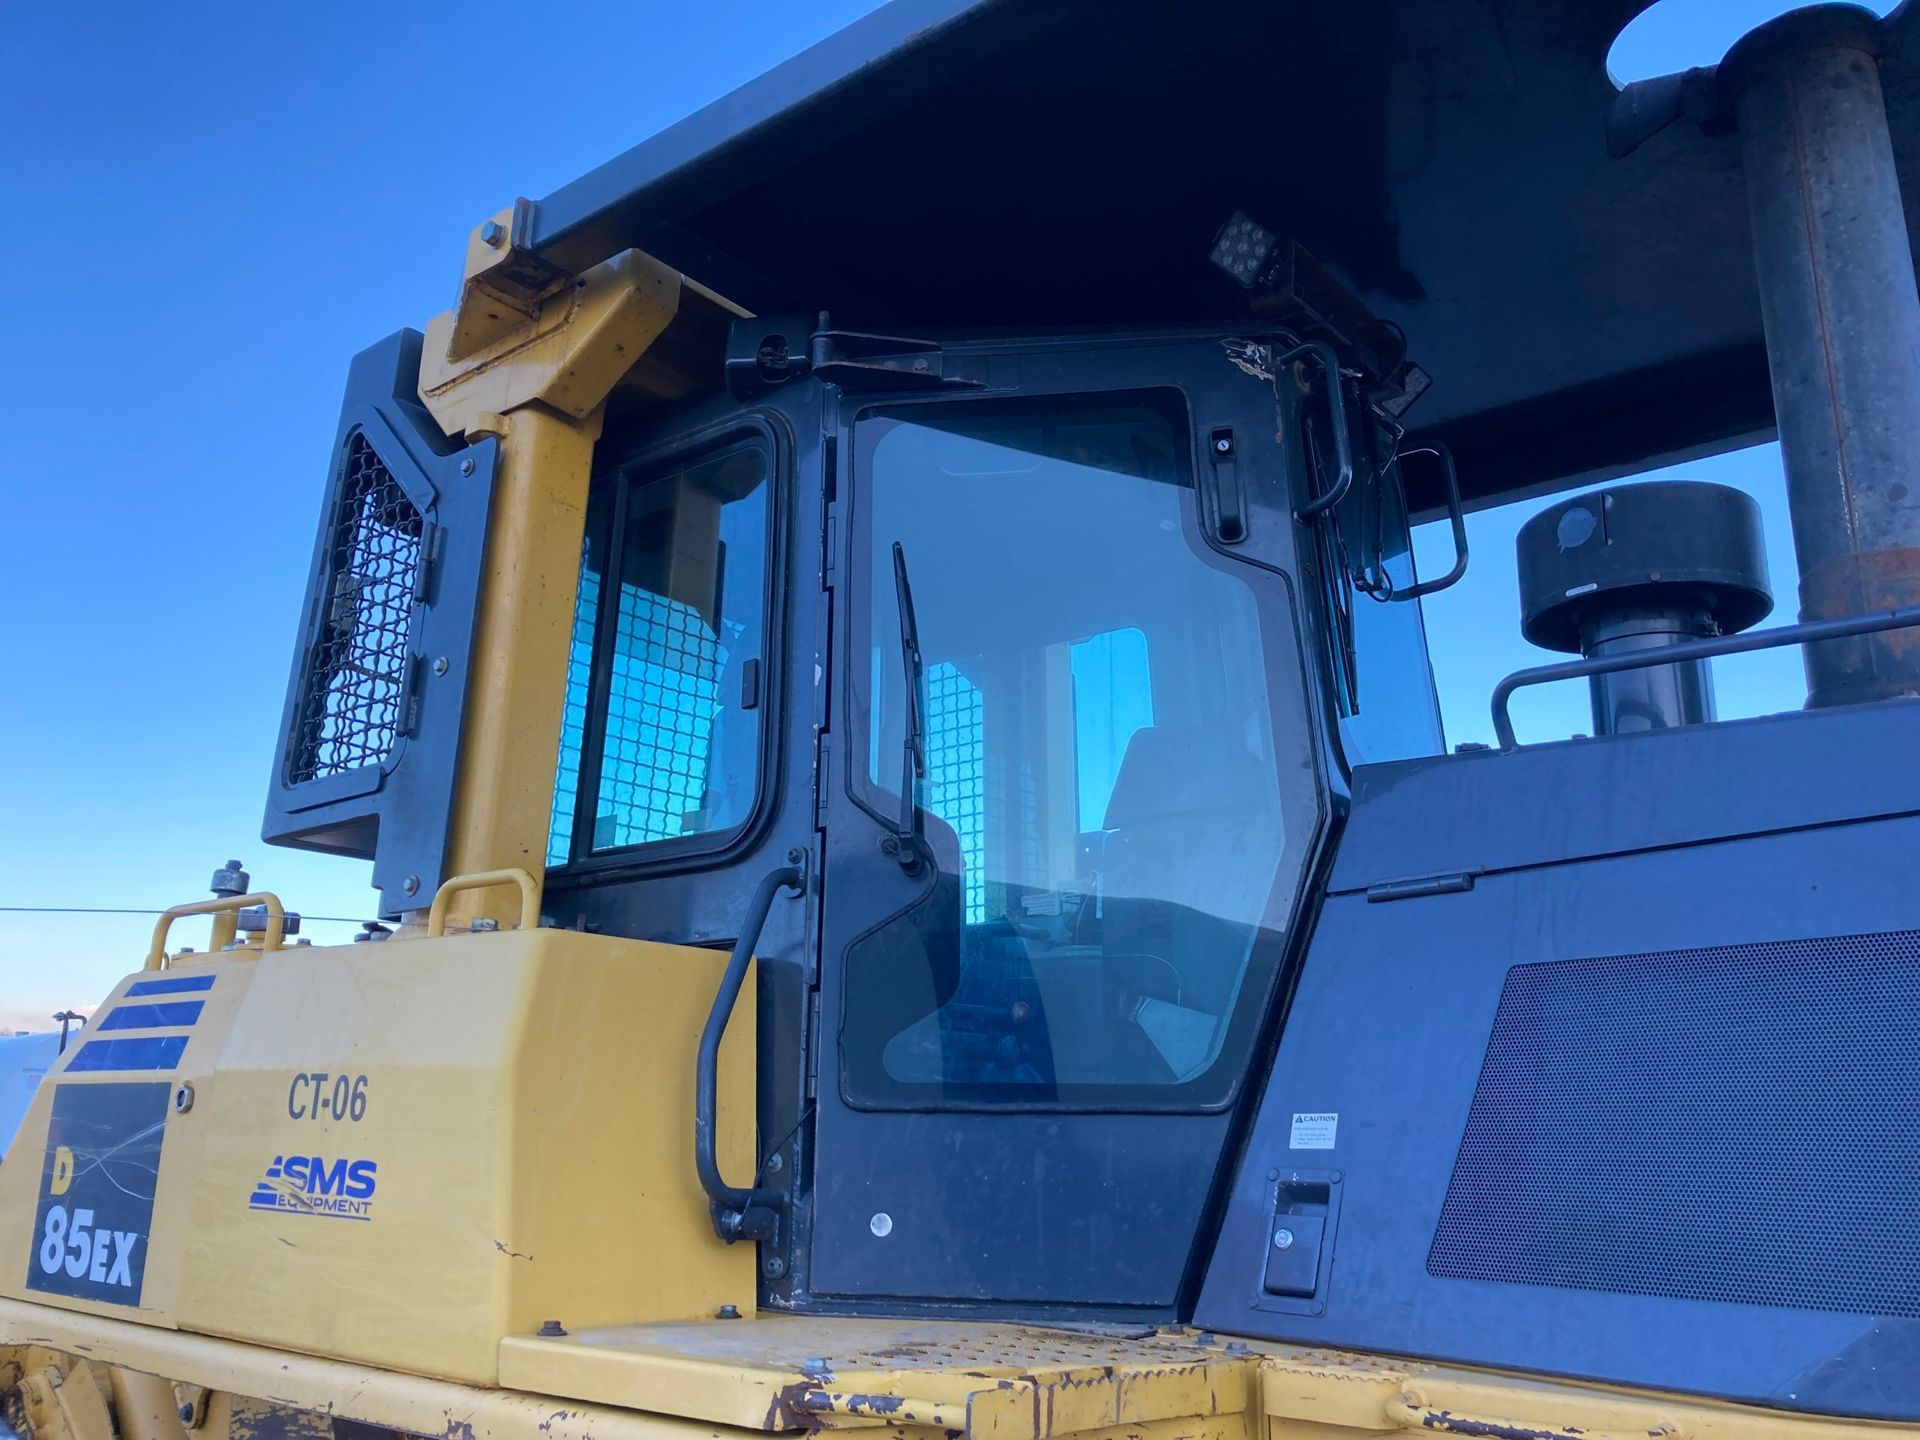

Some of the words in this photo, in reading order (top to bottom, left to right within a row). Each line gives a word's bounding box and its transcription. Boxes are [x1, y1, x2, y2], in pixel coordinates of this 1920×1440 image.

[288, 1073, 368, 1122] CT-06
[50, 1146, 74, 1195] D
[283, 1156, 377, 1199] SMS
[277, 1194, 373, 1214] EQIPMENT
[40, 1205, 138, 1287] 85EX
